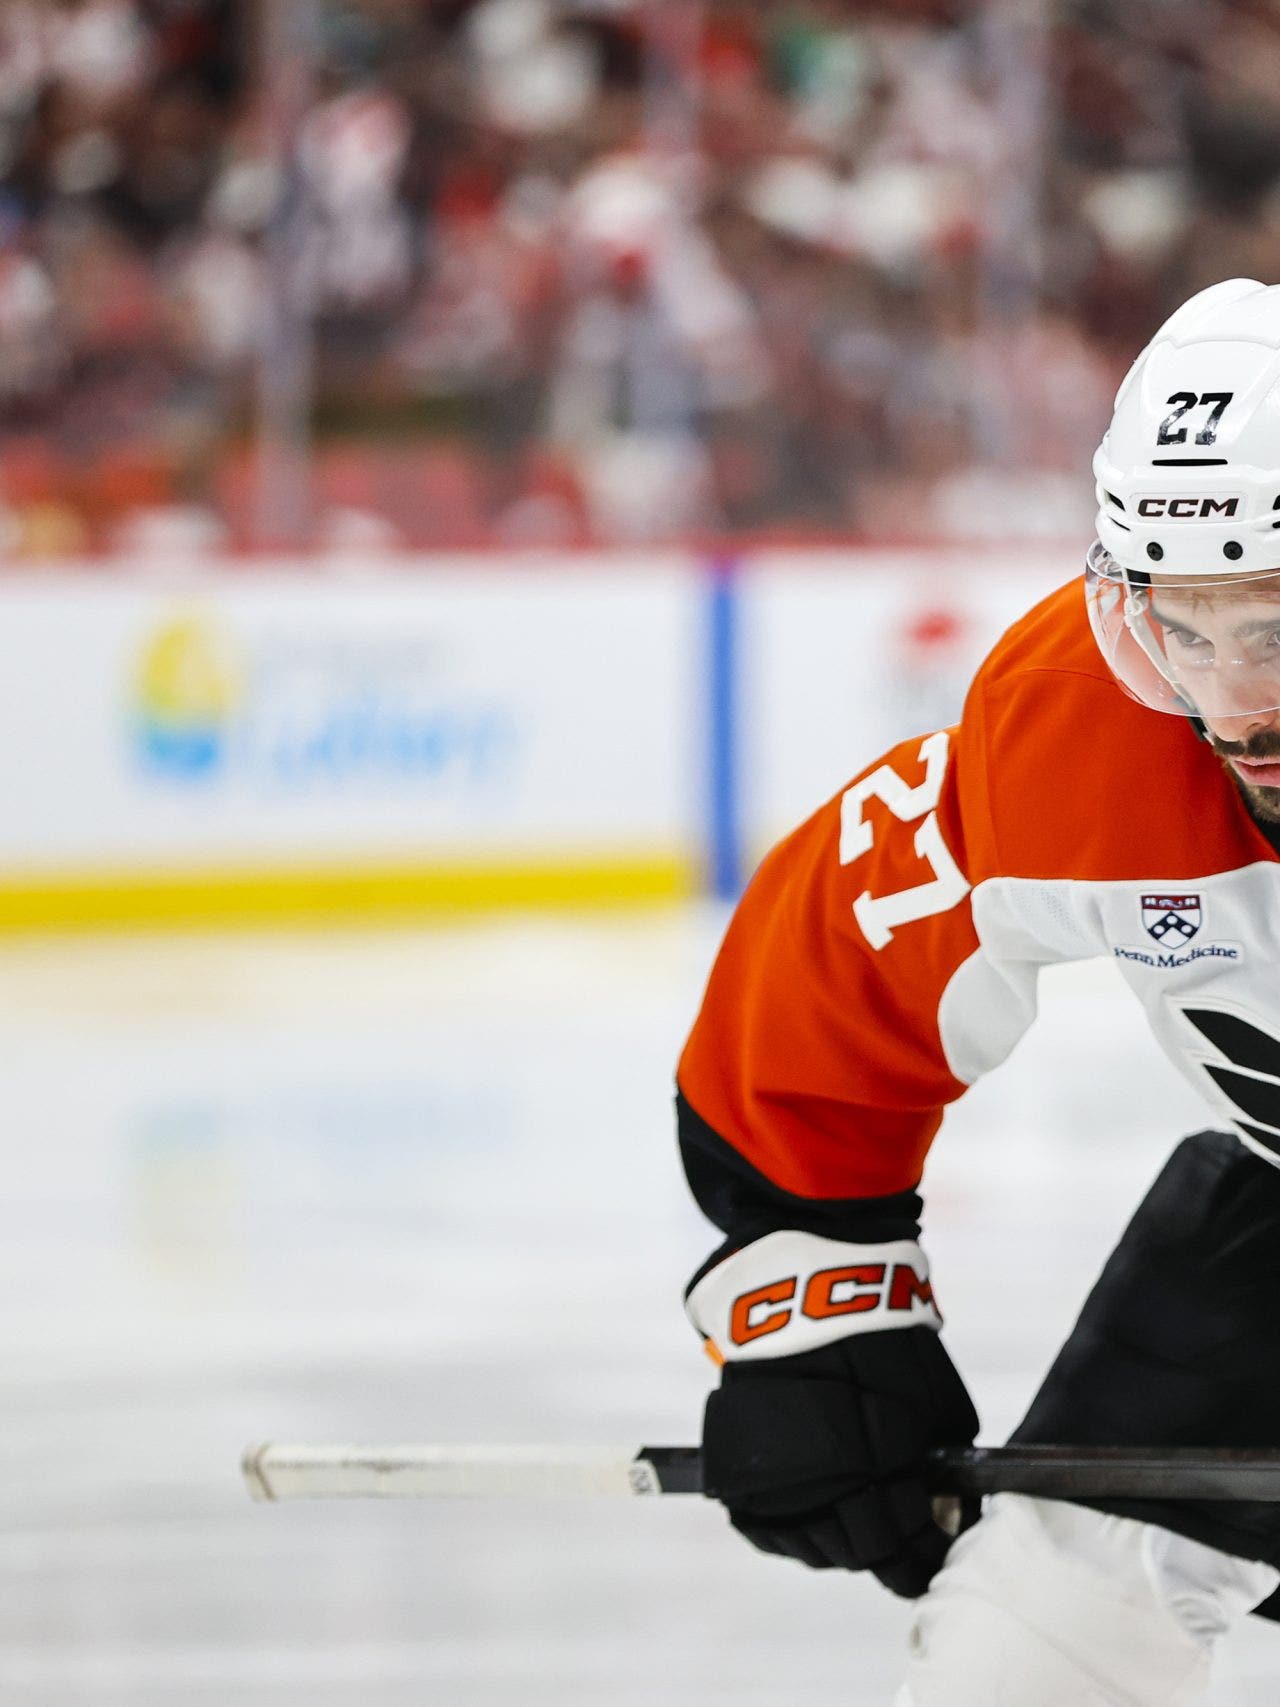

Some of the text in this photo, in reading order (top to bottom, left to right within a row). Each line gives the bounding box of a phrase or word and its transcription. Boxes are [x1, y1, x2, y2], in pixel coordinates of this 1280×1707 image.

[1156, 391, 1235, 447] 27
[1137, 497, 1240, 518] CCM
[839, 731, 972, 952] 27
[1158, 945, 1237, 968] Medicine
